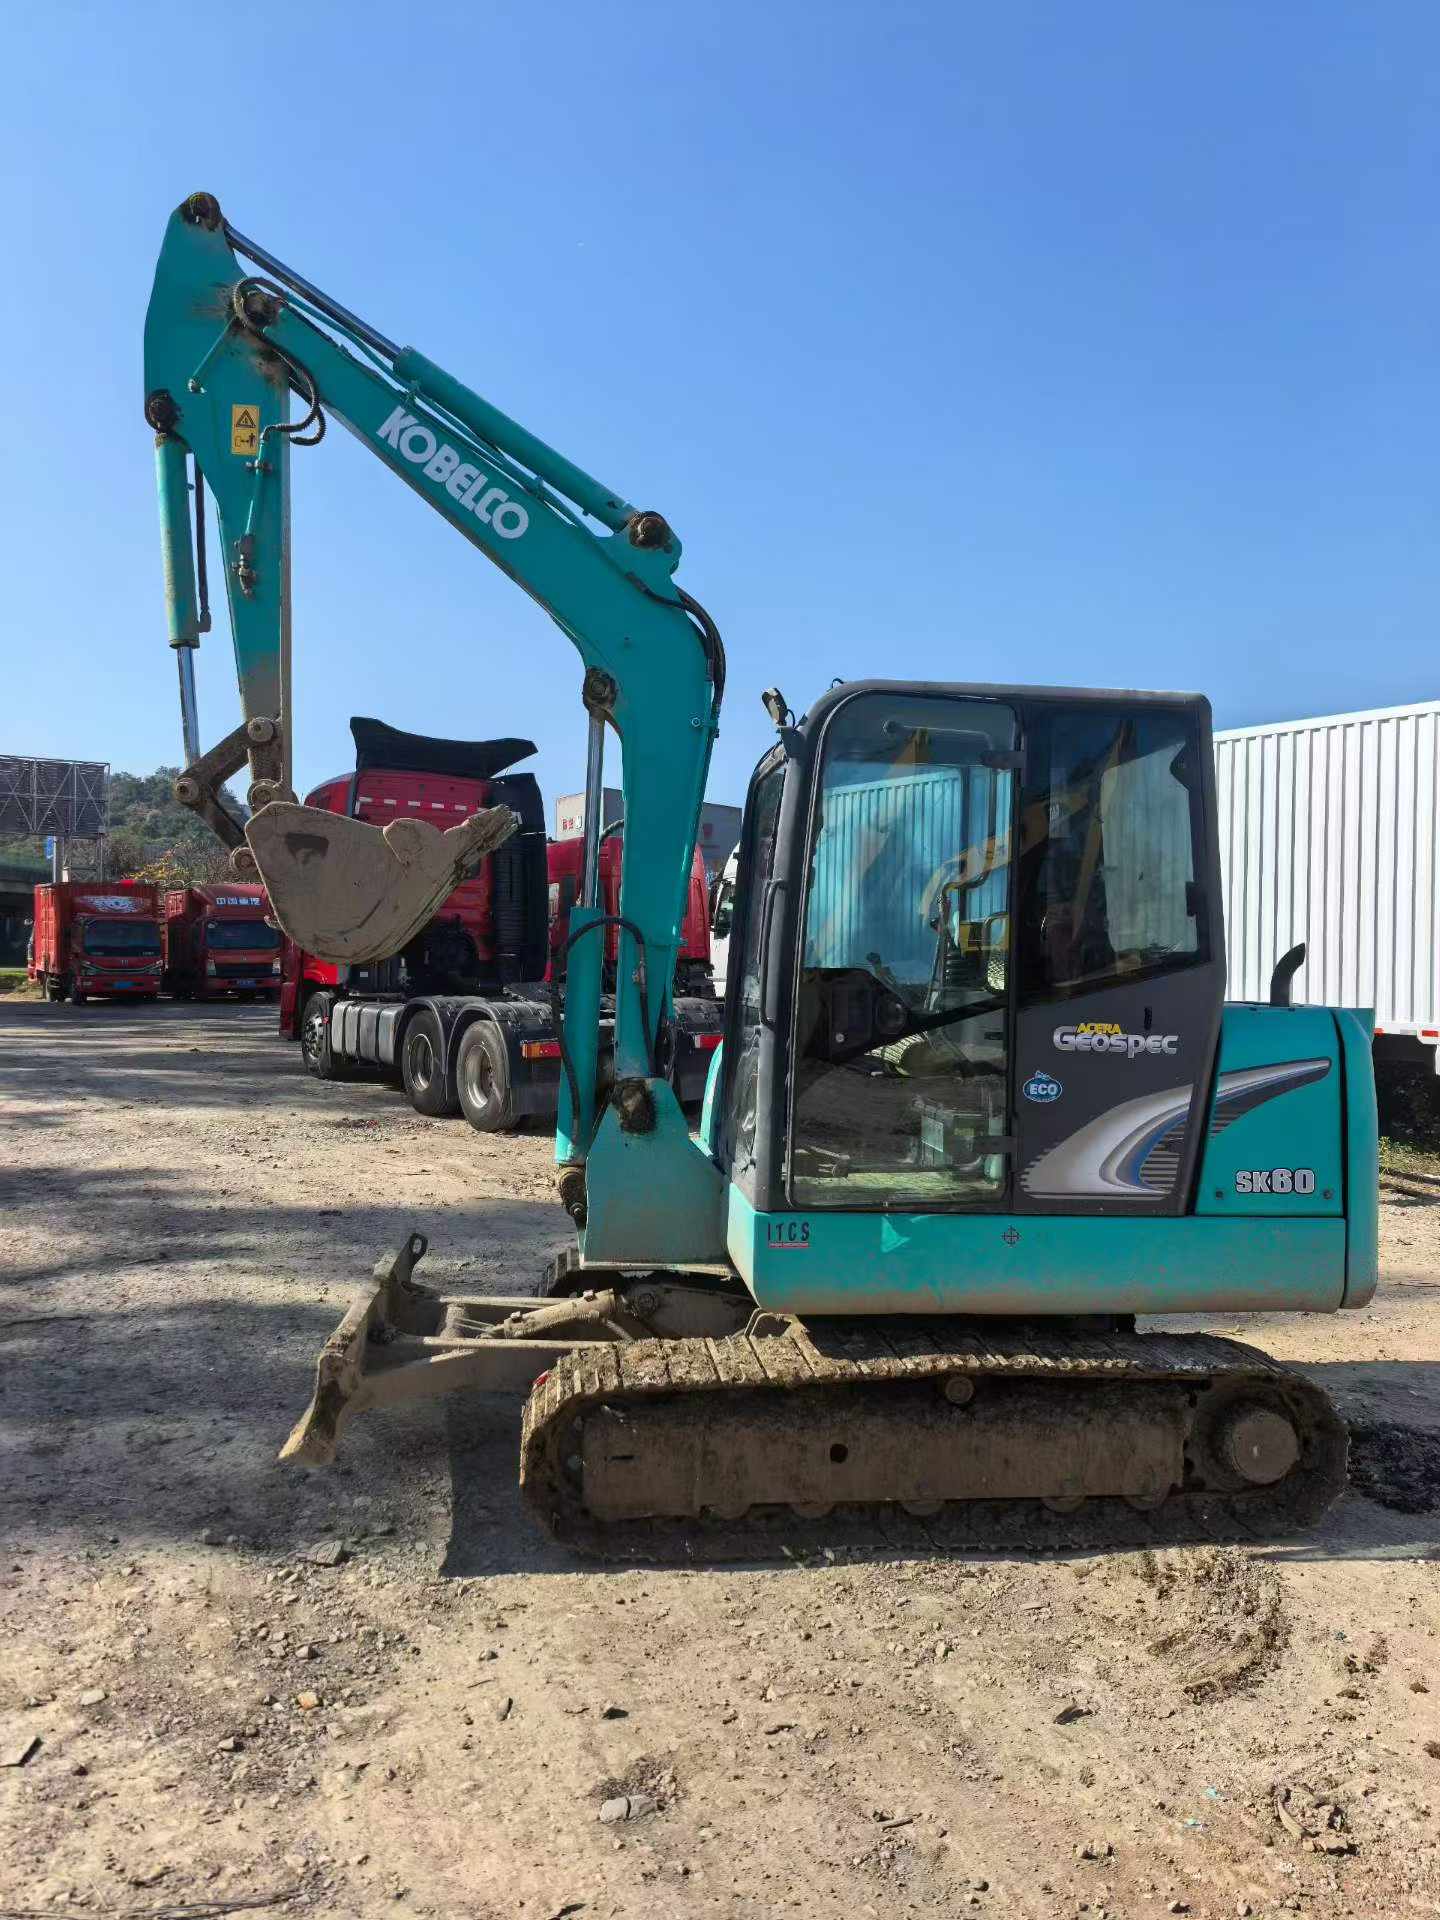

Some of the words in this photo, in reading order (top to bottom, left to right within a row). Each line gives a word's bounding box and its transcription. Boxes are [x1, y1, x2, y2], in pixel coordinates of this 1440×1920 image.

[376, 405, 529, 539] KOBELCO
[1029, 1083, 1057, 1095] ECO
[1236, 1168, 1315, 1193] SK60
[768, 1222, 810, 1241] ITCS
